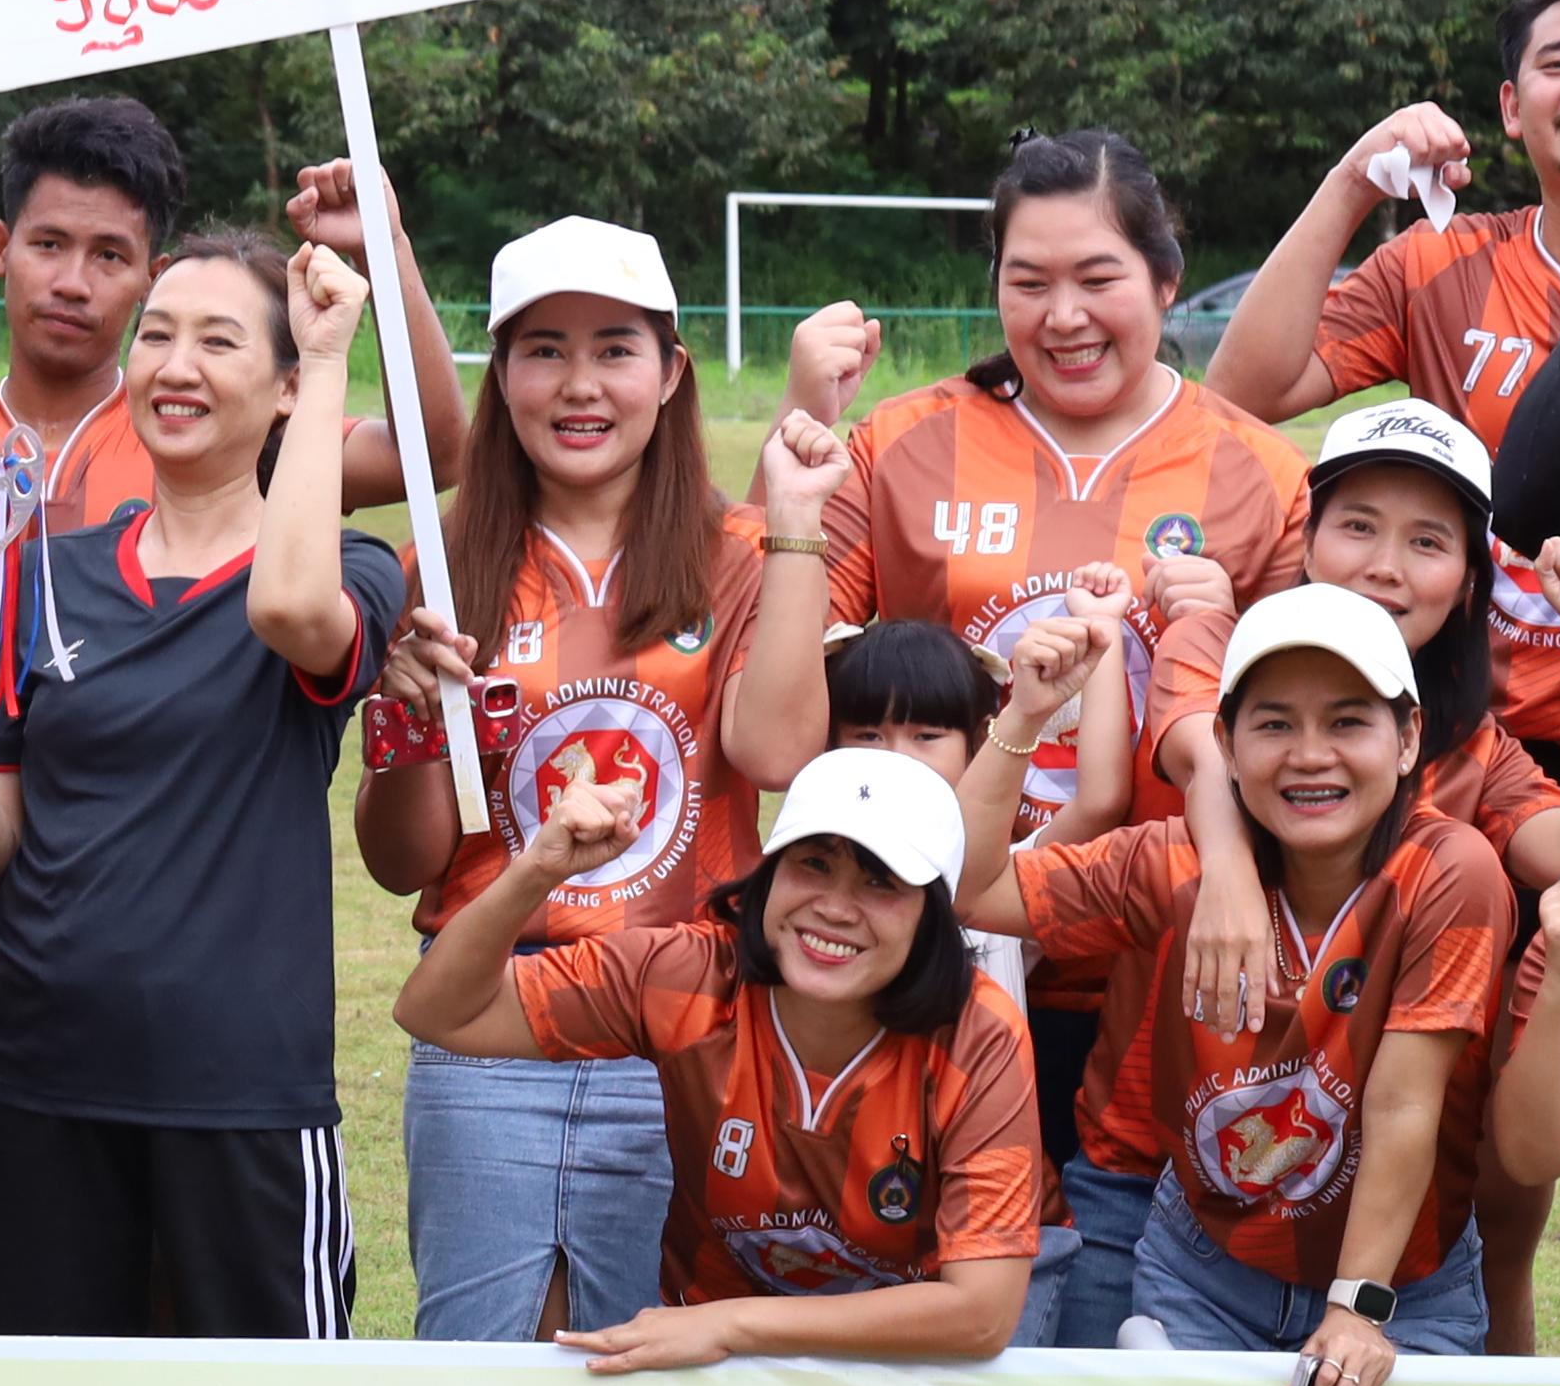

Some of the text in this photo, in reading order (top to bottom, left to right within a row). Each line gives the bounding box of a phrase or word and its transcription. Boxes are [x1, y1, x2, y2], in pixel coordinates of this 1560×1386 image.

[1462, 328, 1534, 398] 77
[933, 500, 1018, 554] 48
[488, 620, 544, 668] 8
[545, 677, 698, 757] ADMINISTRATION
[611, 877, 651, 903] PHET
[653, 781, 702, 878] UNIVERSITY
[713, 1117, 754, 1179] 8
